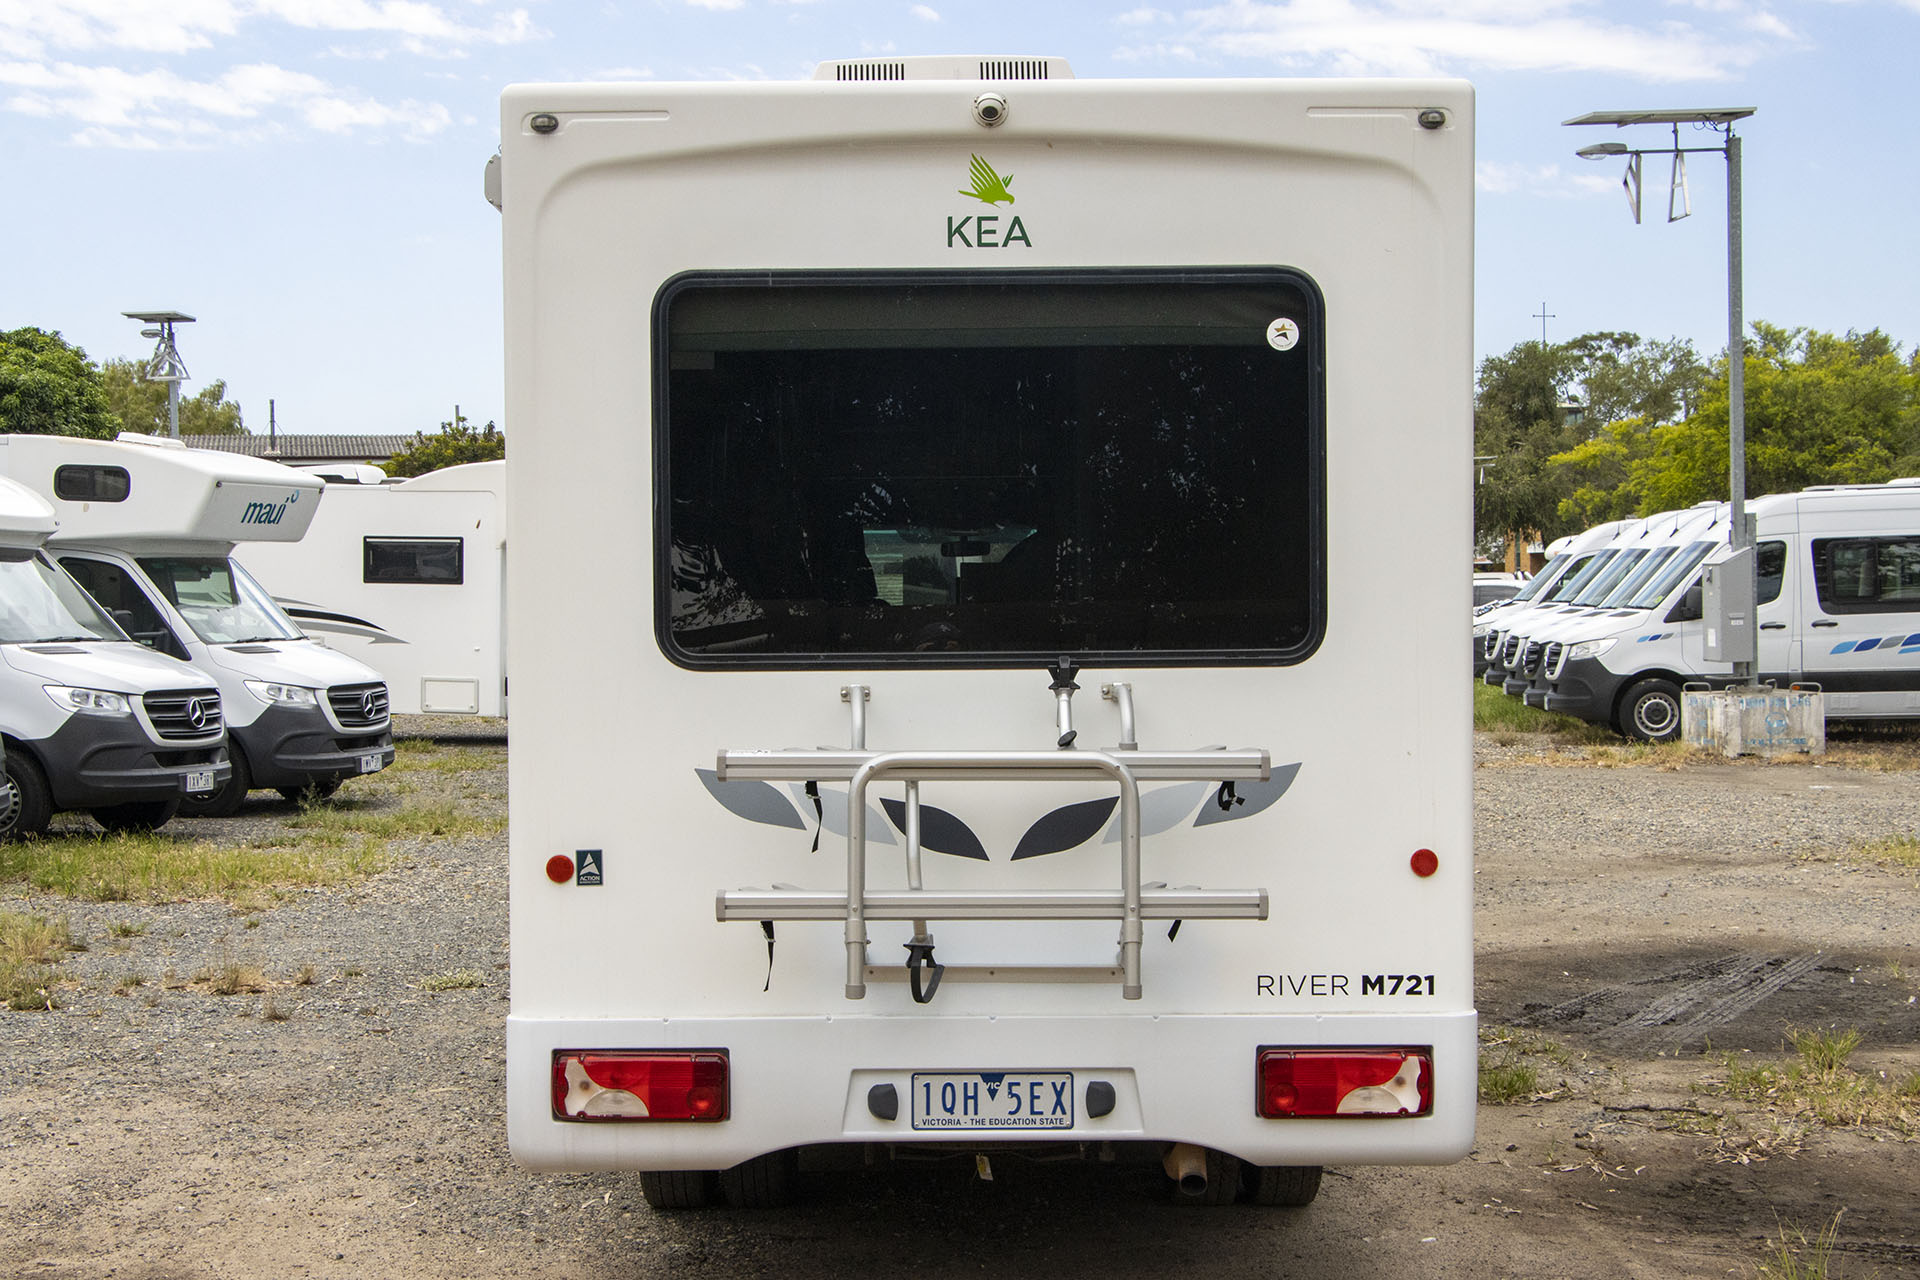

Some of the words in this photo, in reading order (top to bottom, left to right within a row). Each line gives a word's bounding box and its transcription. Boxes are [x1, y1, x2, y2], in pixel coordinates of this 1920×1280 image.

[947, 215, 1033, 248] KEA
[240, 496, 290, 525] maui
[1257, 974, 1350, 996] RIVER
[1361, 974, 1435, 996] M721
[922, 1081, 979, 1116] 1QH
[1007, 1081, 1067, 1116] 5EX
[985, 1082, 1000, 1090] VIC
[922, 1118, 962, 1126] VICTORIA
[970, 1118, 986, 1126] THE
[988, 1118, 1037, 1126] EDUCATION
[1039, 1117, 1065, 1125] STATE
